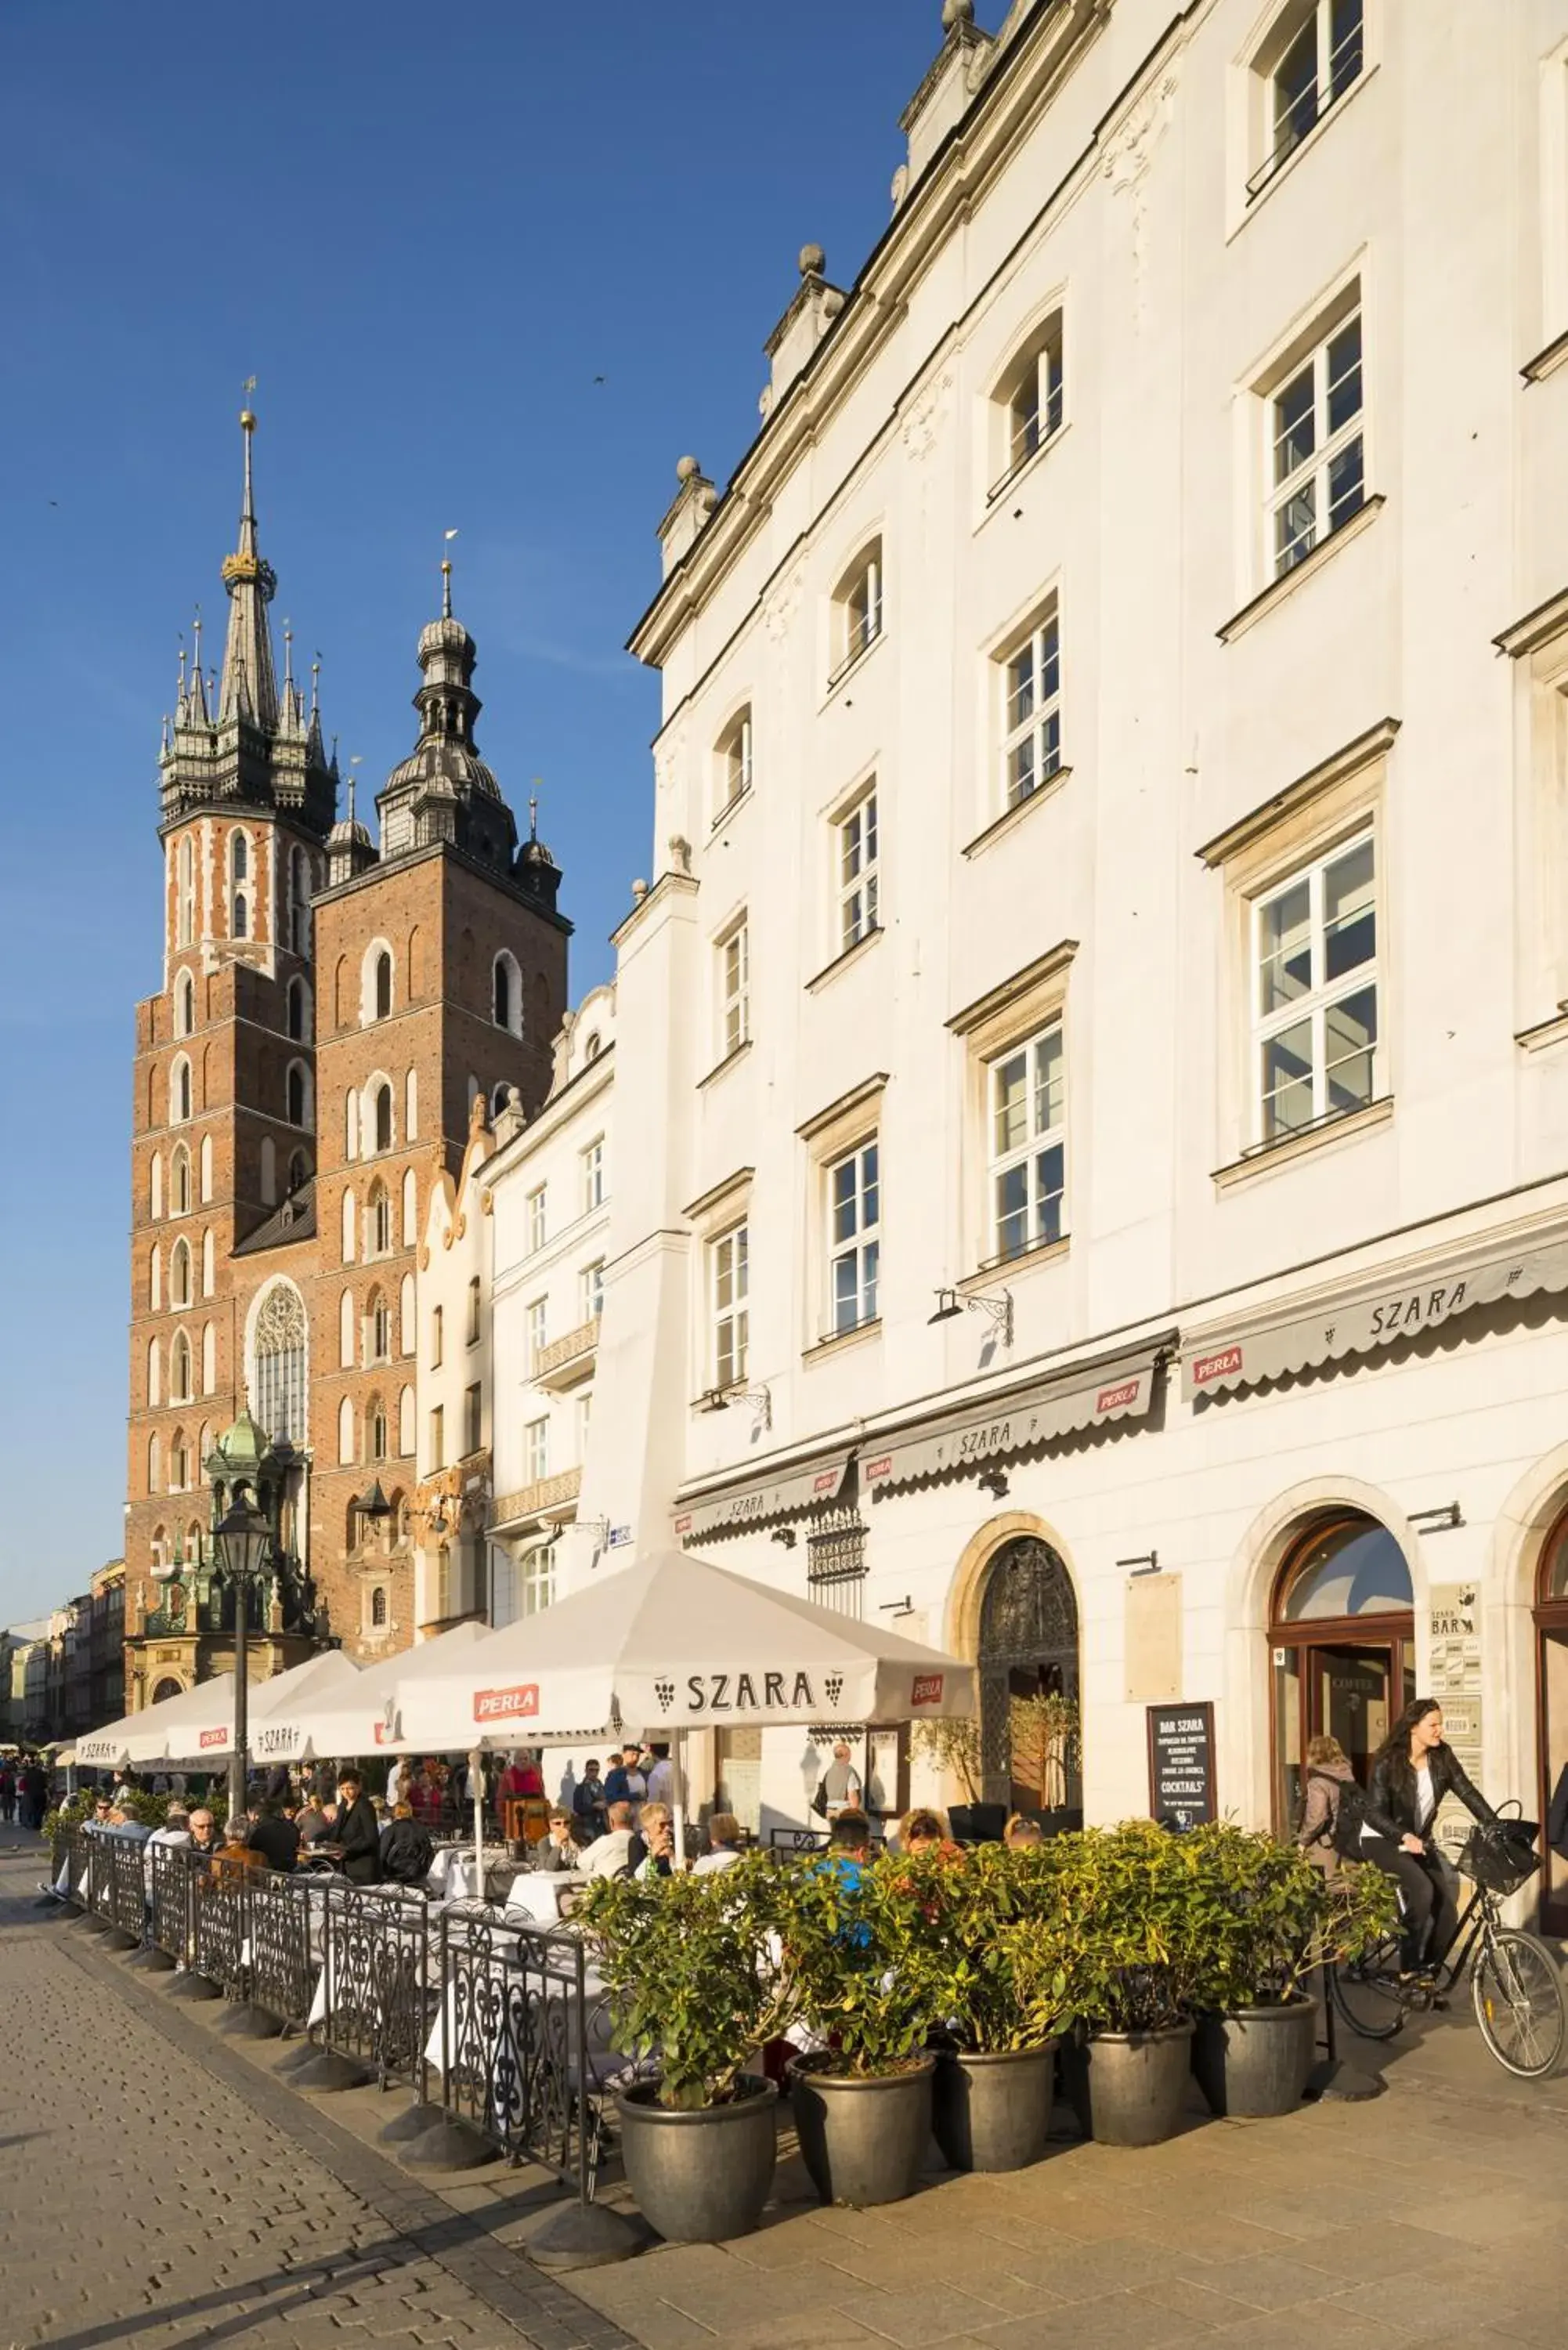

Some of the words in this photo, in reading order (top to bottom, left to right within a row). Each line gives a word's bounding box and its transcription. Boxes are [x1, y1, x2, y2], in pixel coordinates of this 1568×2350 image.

[1370, 1281, 1467, 1336] SZARA
[959, 1422, 1010, 1455] SZARA
[729, 1495, 764, 1517] SZARA
[1432, 1618, 1459, 1635] BAR
[687, 1672, 815, 1713] SZARA
[265, 1727, 293, 1753] SZARA
